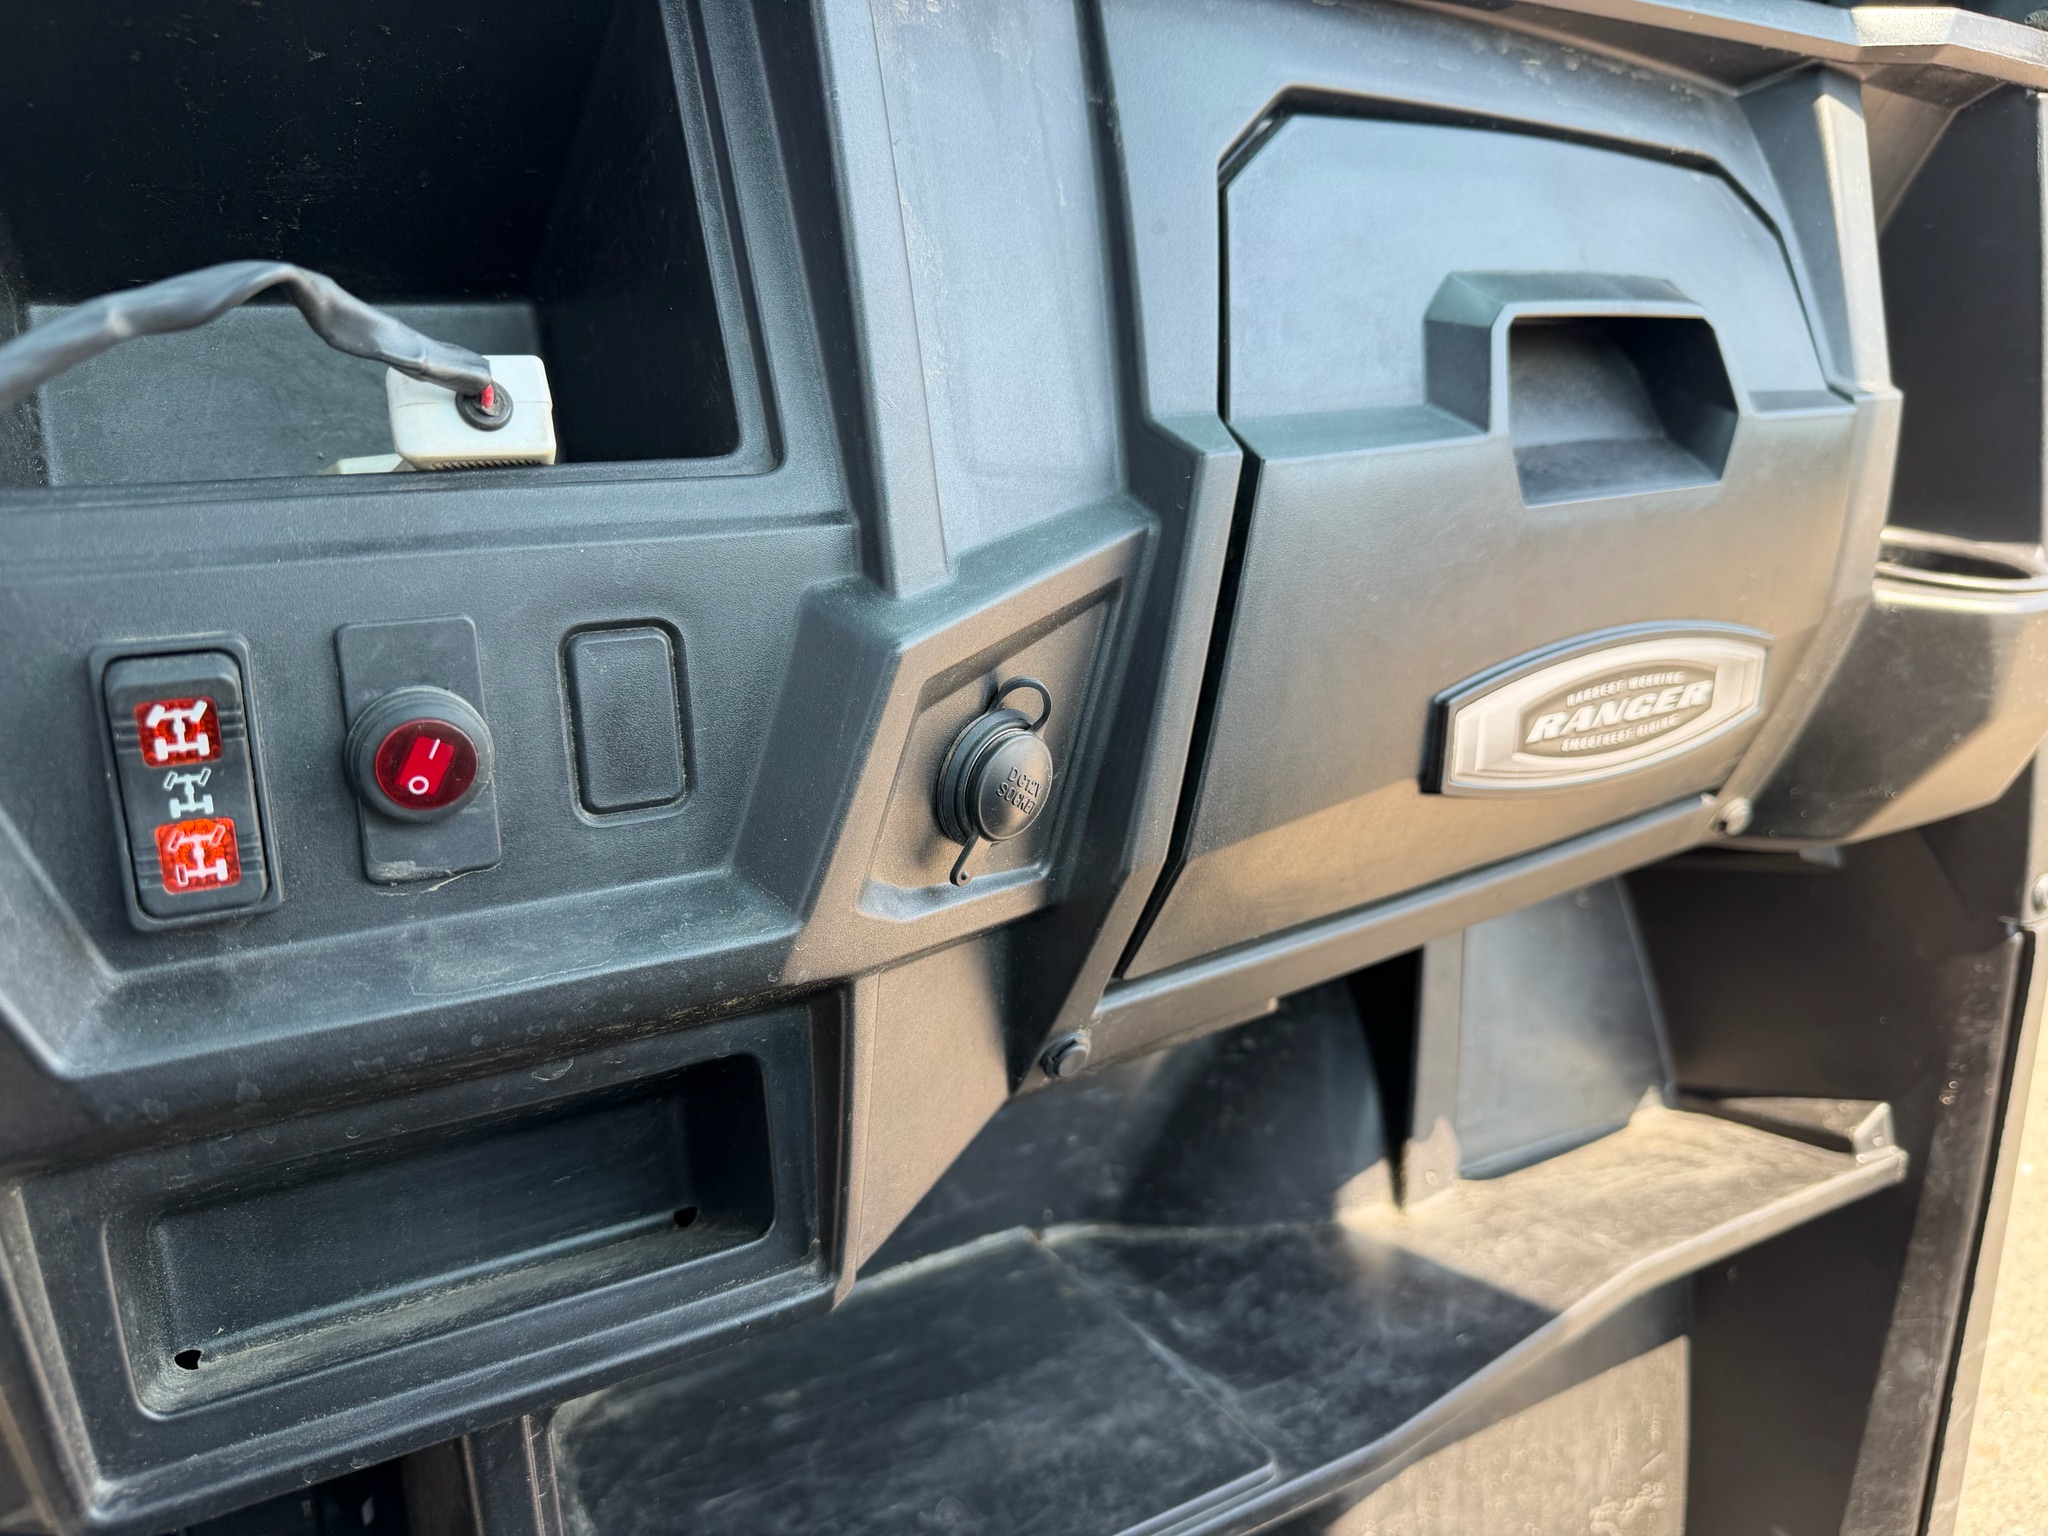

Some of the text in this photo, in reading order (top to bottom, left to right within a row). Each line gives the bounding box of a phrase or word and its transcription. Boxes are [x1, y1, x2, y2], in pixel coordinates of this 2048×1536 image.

[1566, 671, 1687, 707] HARDEST WORKING
[1525, 680, 1714, 744] RANGER
[1561, 714, 1682, 751] SMOOTHEST RIDING
[996, 782, 1036, 816] SOCKET
